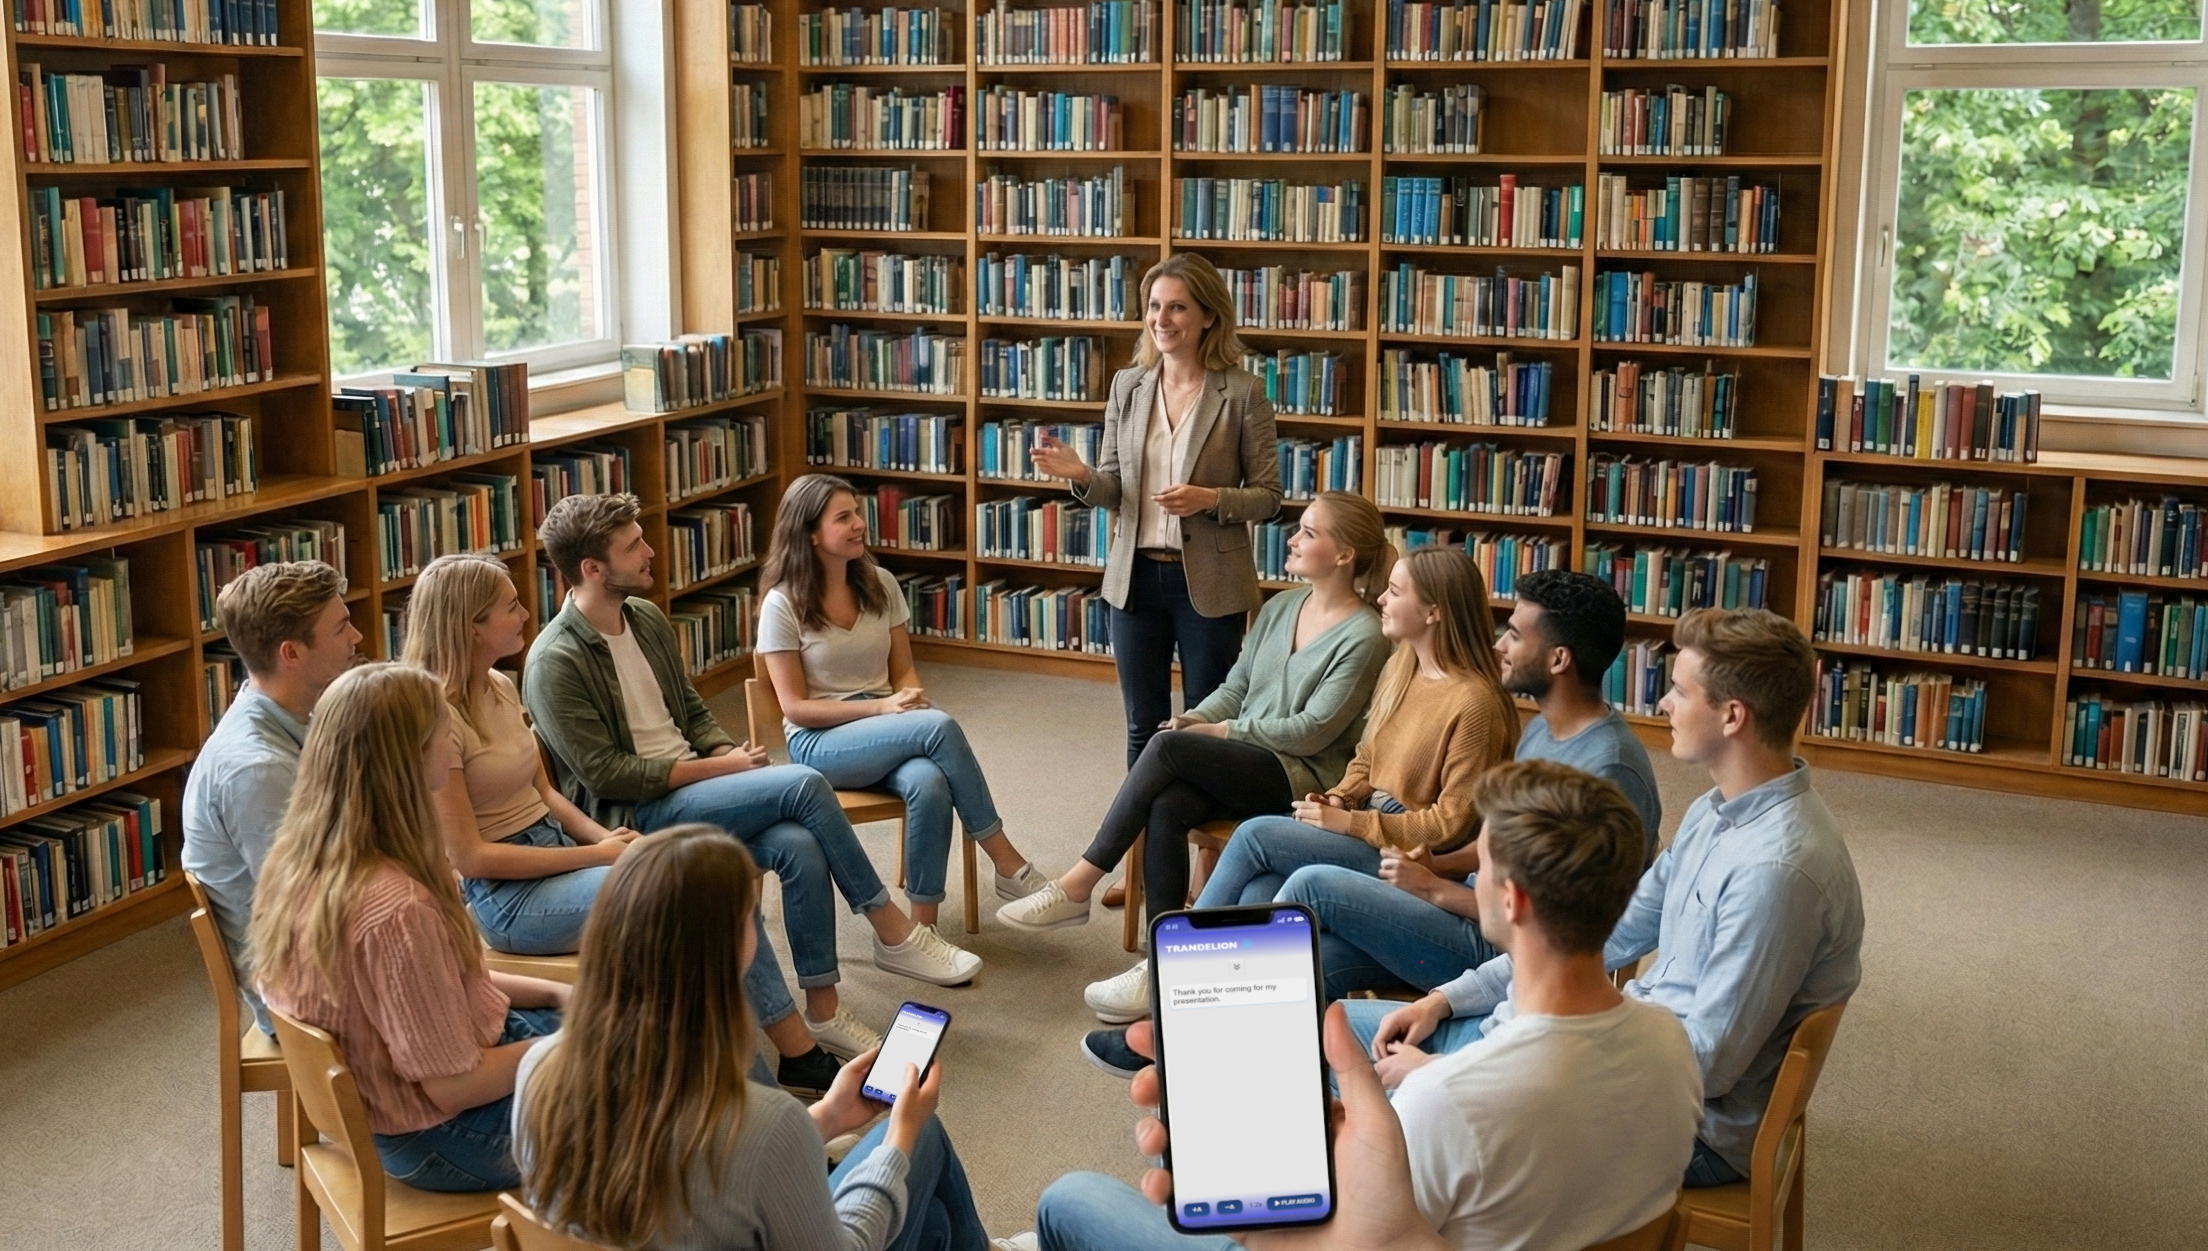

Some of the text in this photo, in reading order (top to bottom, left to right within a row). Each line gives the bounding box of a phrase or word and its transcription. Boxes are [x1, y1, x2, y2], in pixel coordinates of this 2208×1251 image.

[1165, 941, 1238, 953] TRANDELION
[1173, 989, 1196, 997] Thank
[1225, 985, 1251, 993] coming
[1173, 996, 1221, 1006] presentation.
[1296, 1197, 1316, 1205] AUDIO
